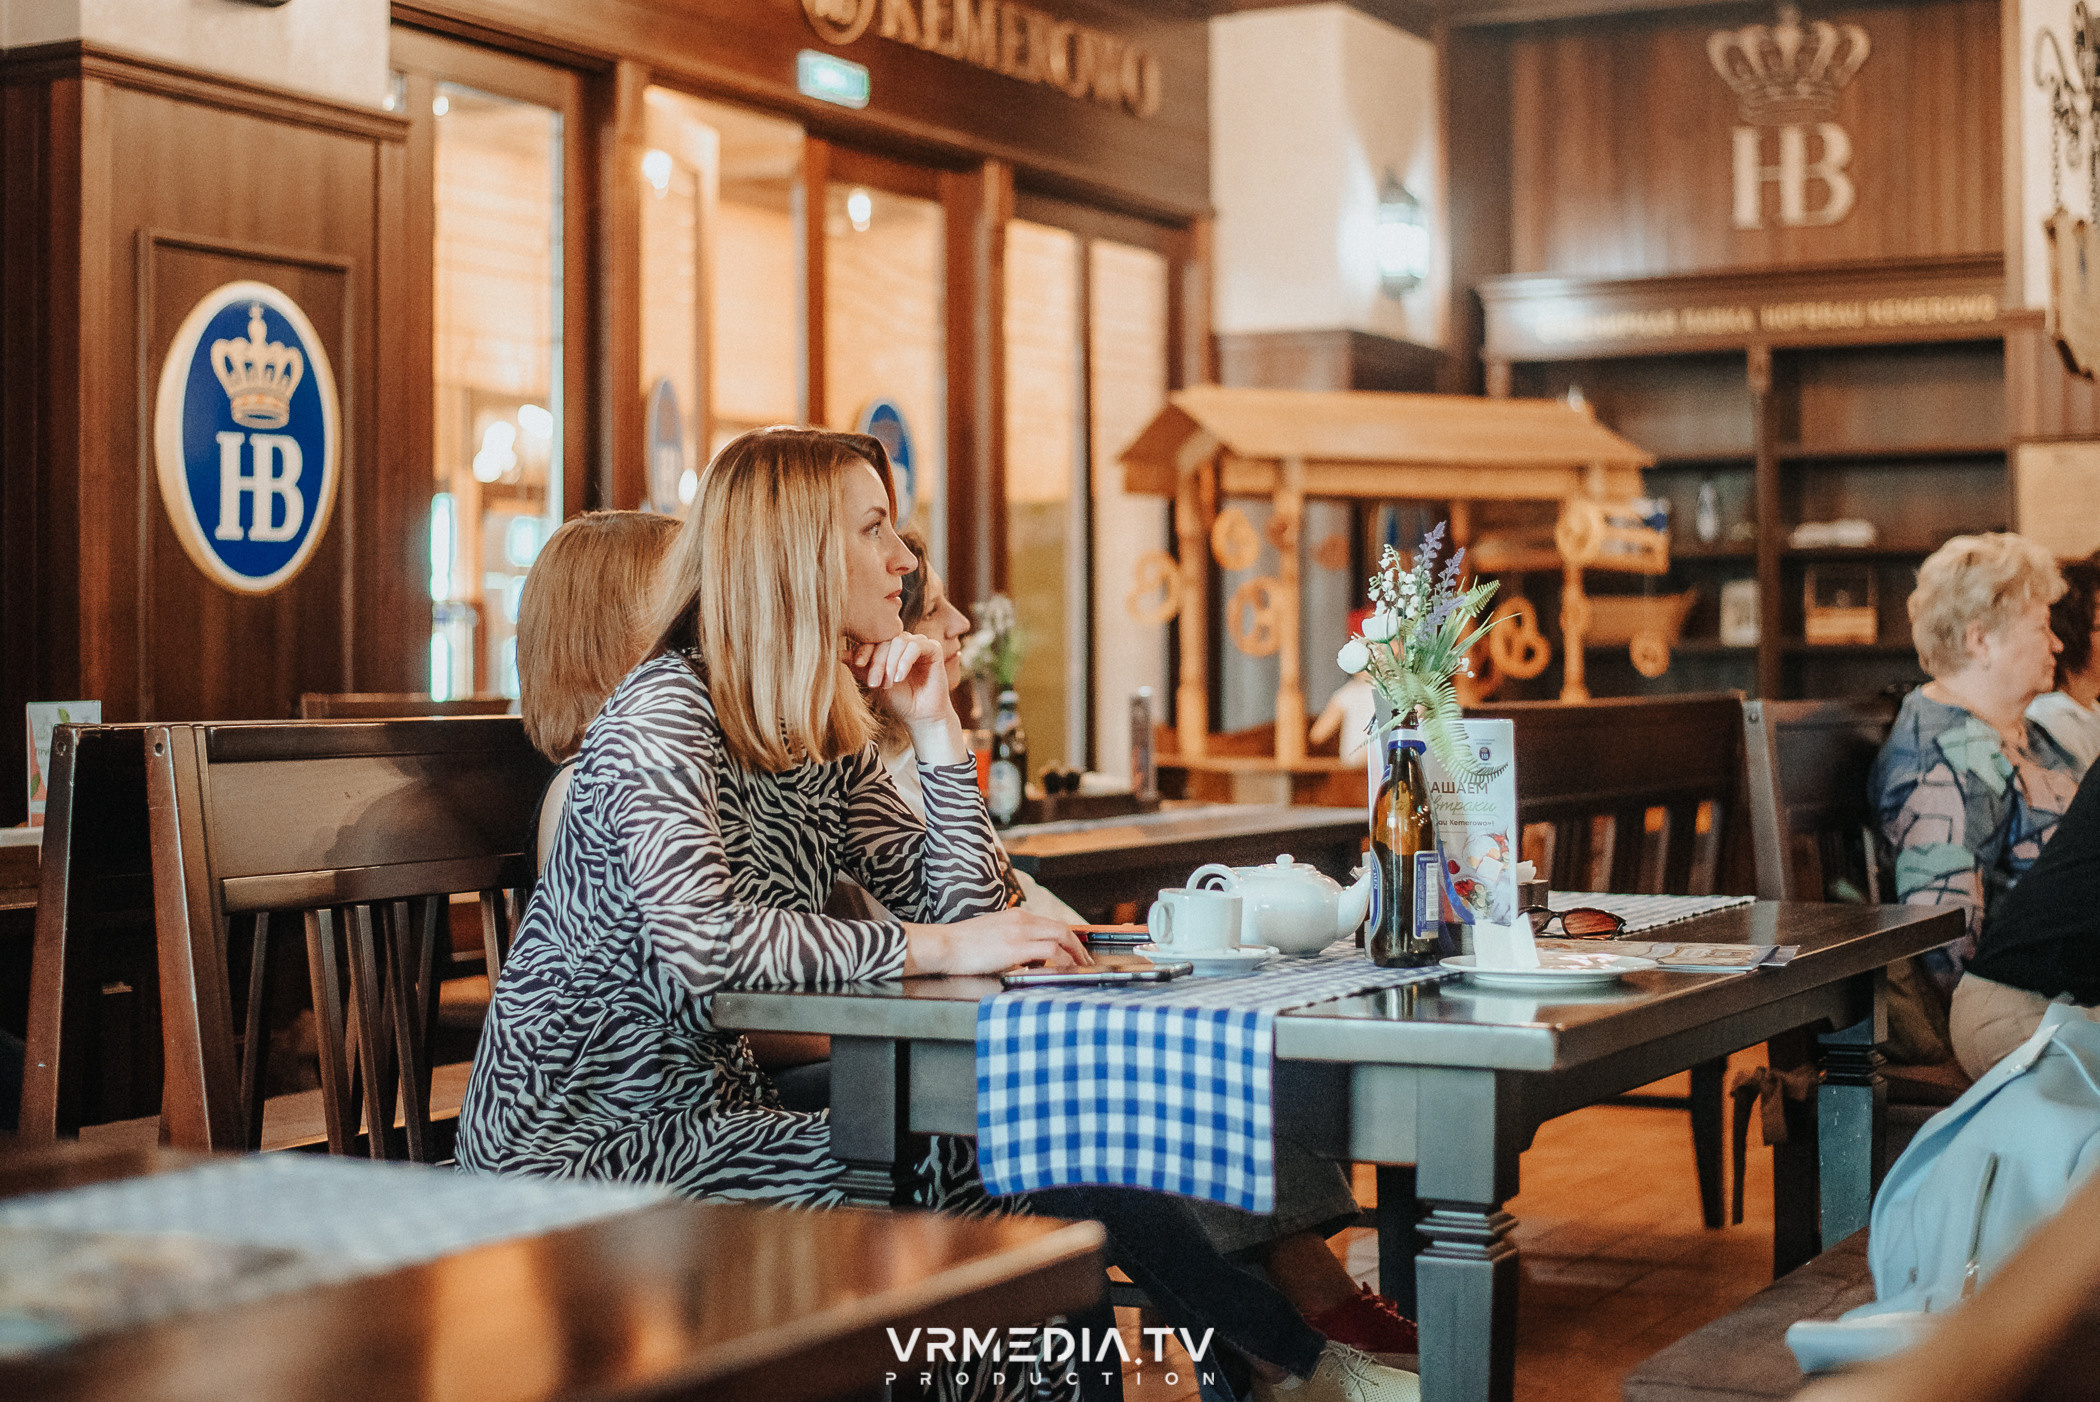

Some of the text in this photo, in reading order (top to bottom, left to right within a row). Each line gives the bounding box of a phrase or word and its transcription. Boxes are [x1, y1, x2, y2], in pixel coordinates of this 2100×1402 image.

[1731, 121, 1856, 229] HB
[215, 431, 304, 542] HB
[1428, 781, 1488, 794] АШАЕМ
[1433, 794, 1497, 814] втраки
